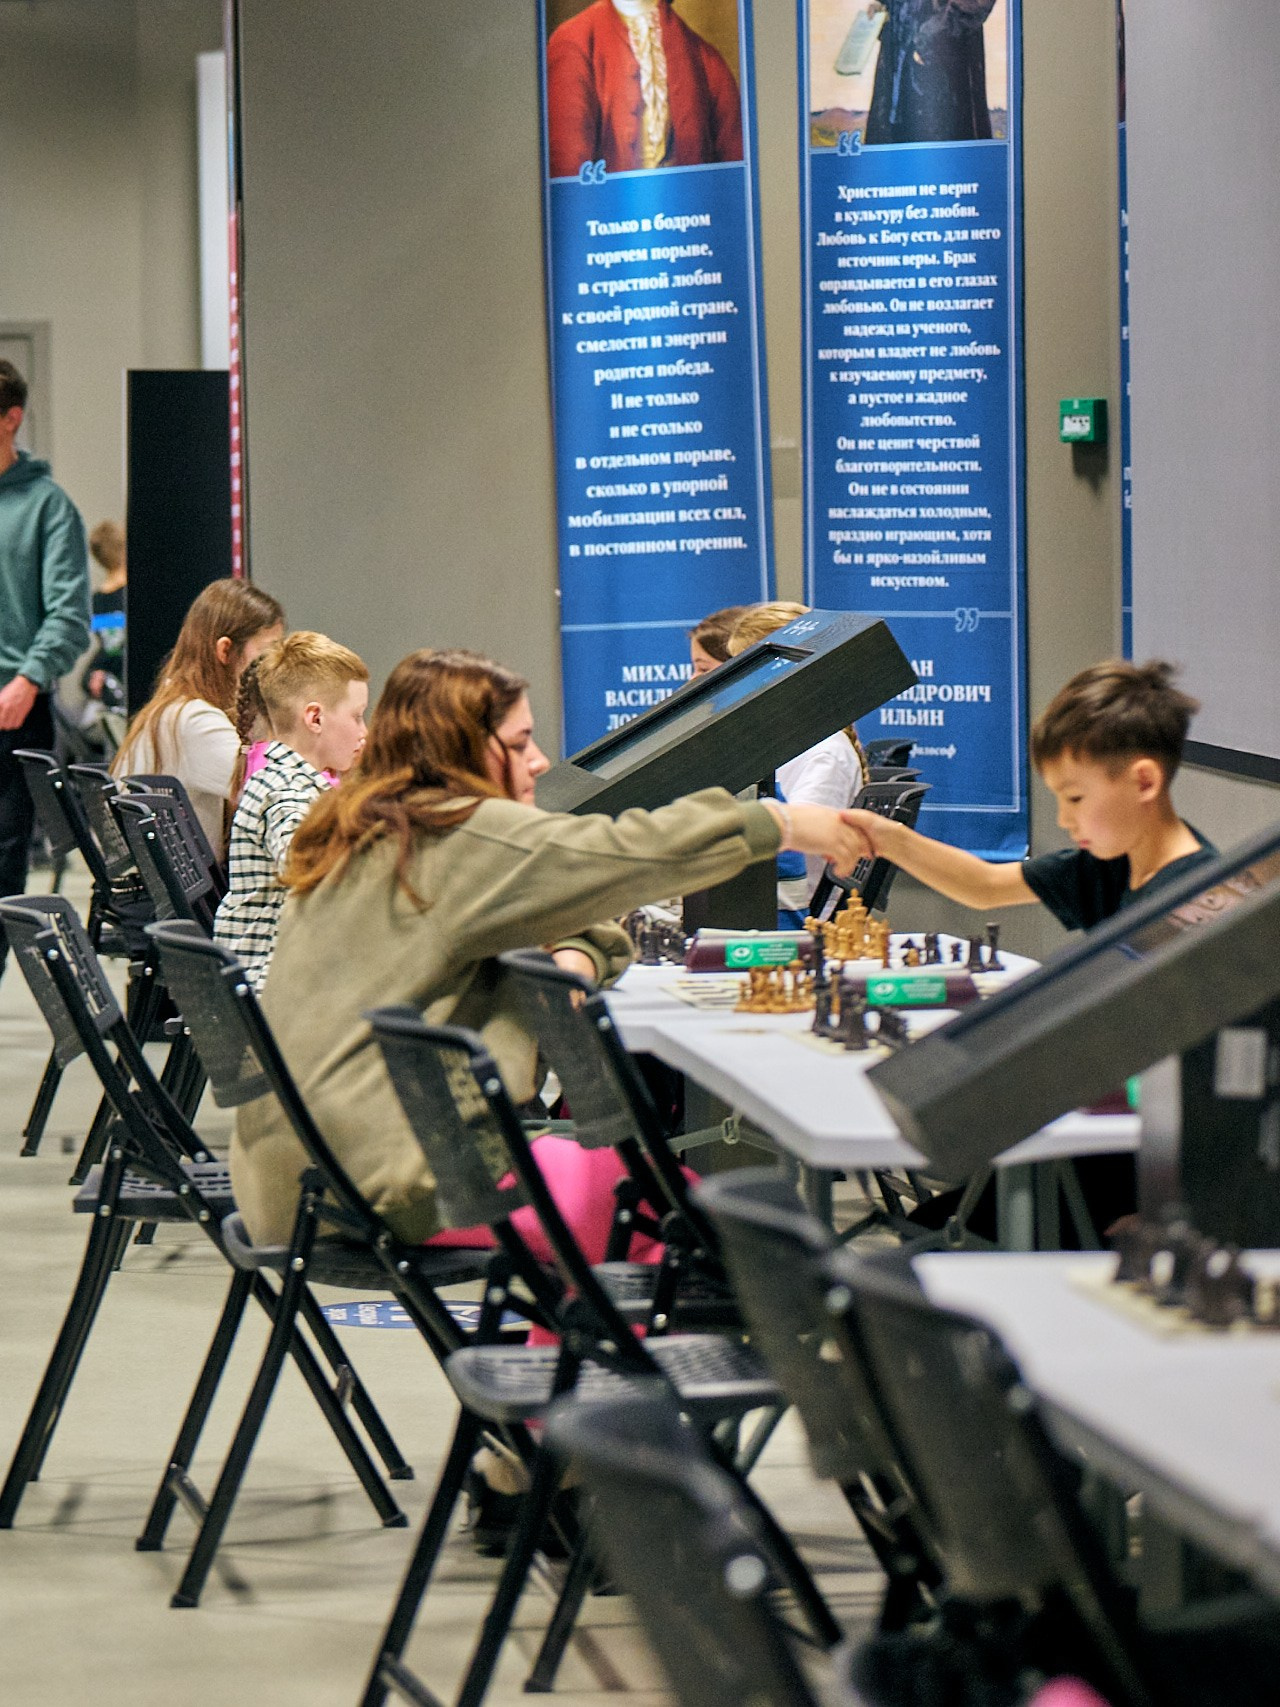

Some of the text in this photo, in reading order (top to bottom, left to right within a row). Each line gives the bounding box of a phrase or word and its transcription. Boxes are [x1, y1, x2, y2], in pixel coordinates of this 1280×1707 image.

[838, 183, 978, 202] Христианин не верит
[835, 211, 842, 222] в
[845, 209, 904, 224] культуру
[906, 204, 927, 219] без
[586, 213, 711, 236] Только в бодром
[817, 229, 1000, 247] Любовь к Богу есть для него
[587, 243, 713, 268] горячем порыве,
[838, 255, 901, 268] источник
[943, 251, 976, 268] Брак
[578, 269, 722, 296] в страстной любви
[918, 277, 926, 288] в
[929, 276, 953, 287] его
[956, 275, 997, 286] глазах
[562, 300, 738, 325] к своей родной стране,
[890, 298, 906, 311] Он
[909, 300, 924, 311] не
[927, 298, 993, 311] возлагает
[844, 324, 894, 336] надежд
[896, 324, 910, 335] на
[577, 331, 727, 353] смелости и энергии
[819, 341, 1001, 363] которым владеет не любовь
[594, 359, 714, 386] родится победа.
[830, 371, 838, 382] к
[612, 392, 699, 409] И не только
[848, 391, 968, 407] а пустое и жадное
[610, 421, 702, 438] и не столько
[837, 434, 980, 452] Он не ценит черствой
[576, 449, 736, 469] в отдельном порыве,
[586, 474, 728, 498] сколько в упорной
[849, 482, 969, 496] Он не в состоянии
[569, 507, 746, 528] мобилизации всех сил,
[963, 530, 991, 540] хотя
[570, 536, 747, 557] в постоянном горении.
[834, 550, 852, 564] бы
[854, 553, 864, 564] и
[871, 576, 949, 590] искусством.
[622, 663, 692, 683] МИХАИ
[605, 687, 672, 707] ВАСИЛ
[896, 684, 991, 703] НДРОВИЧ
[880, 708, 944, 726] ИЛЬИН
